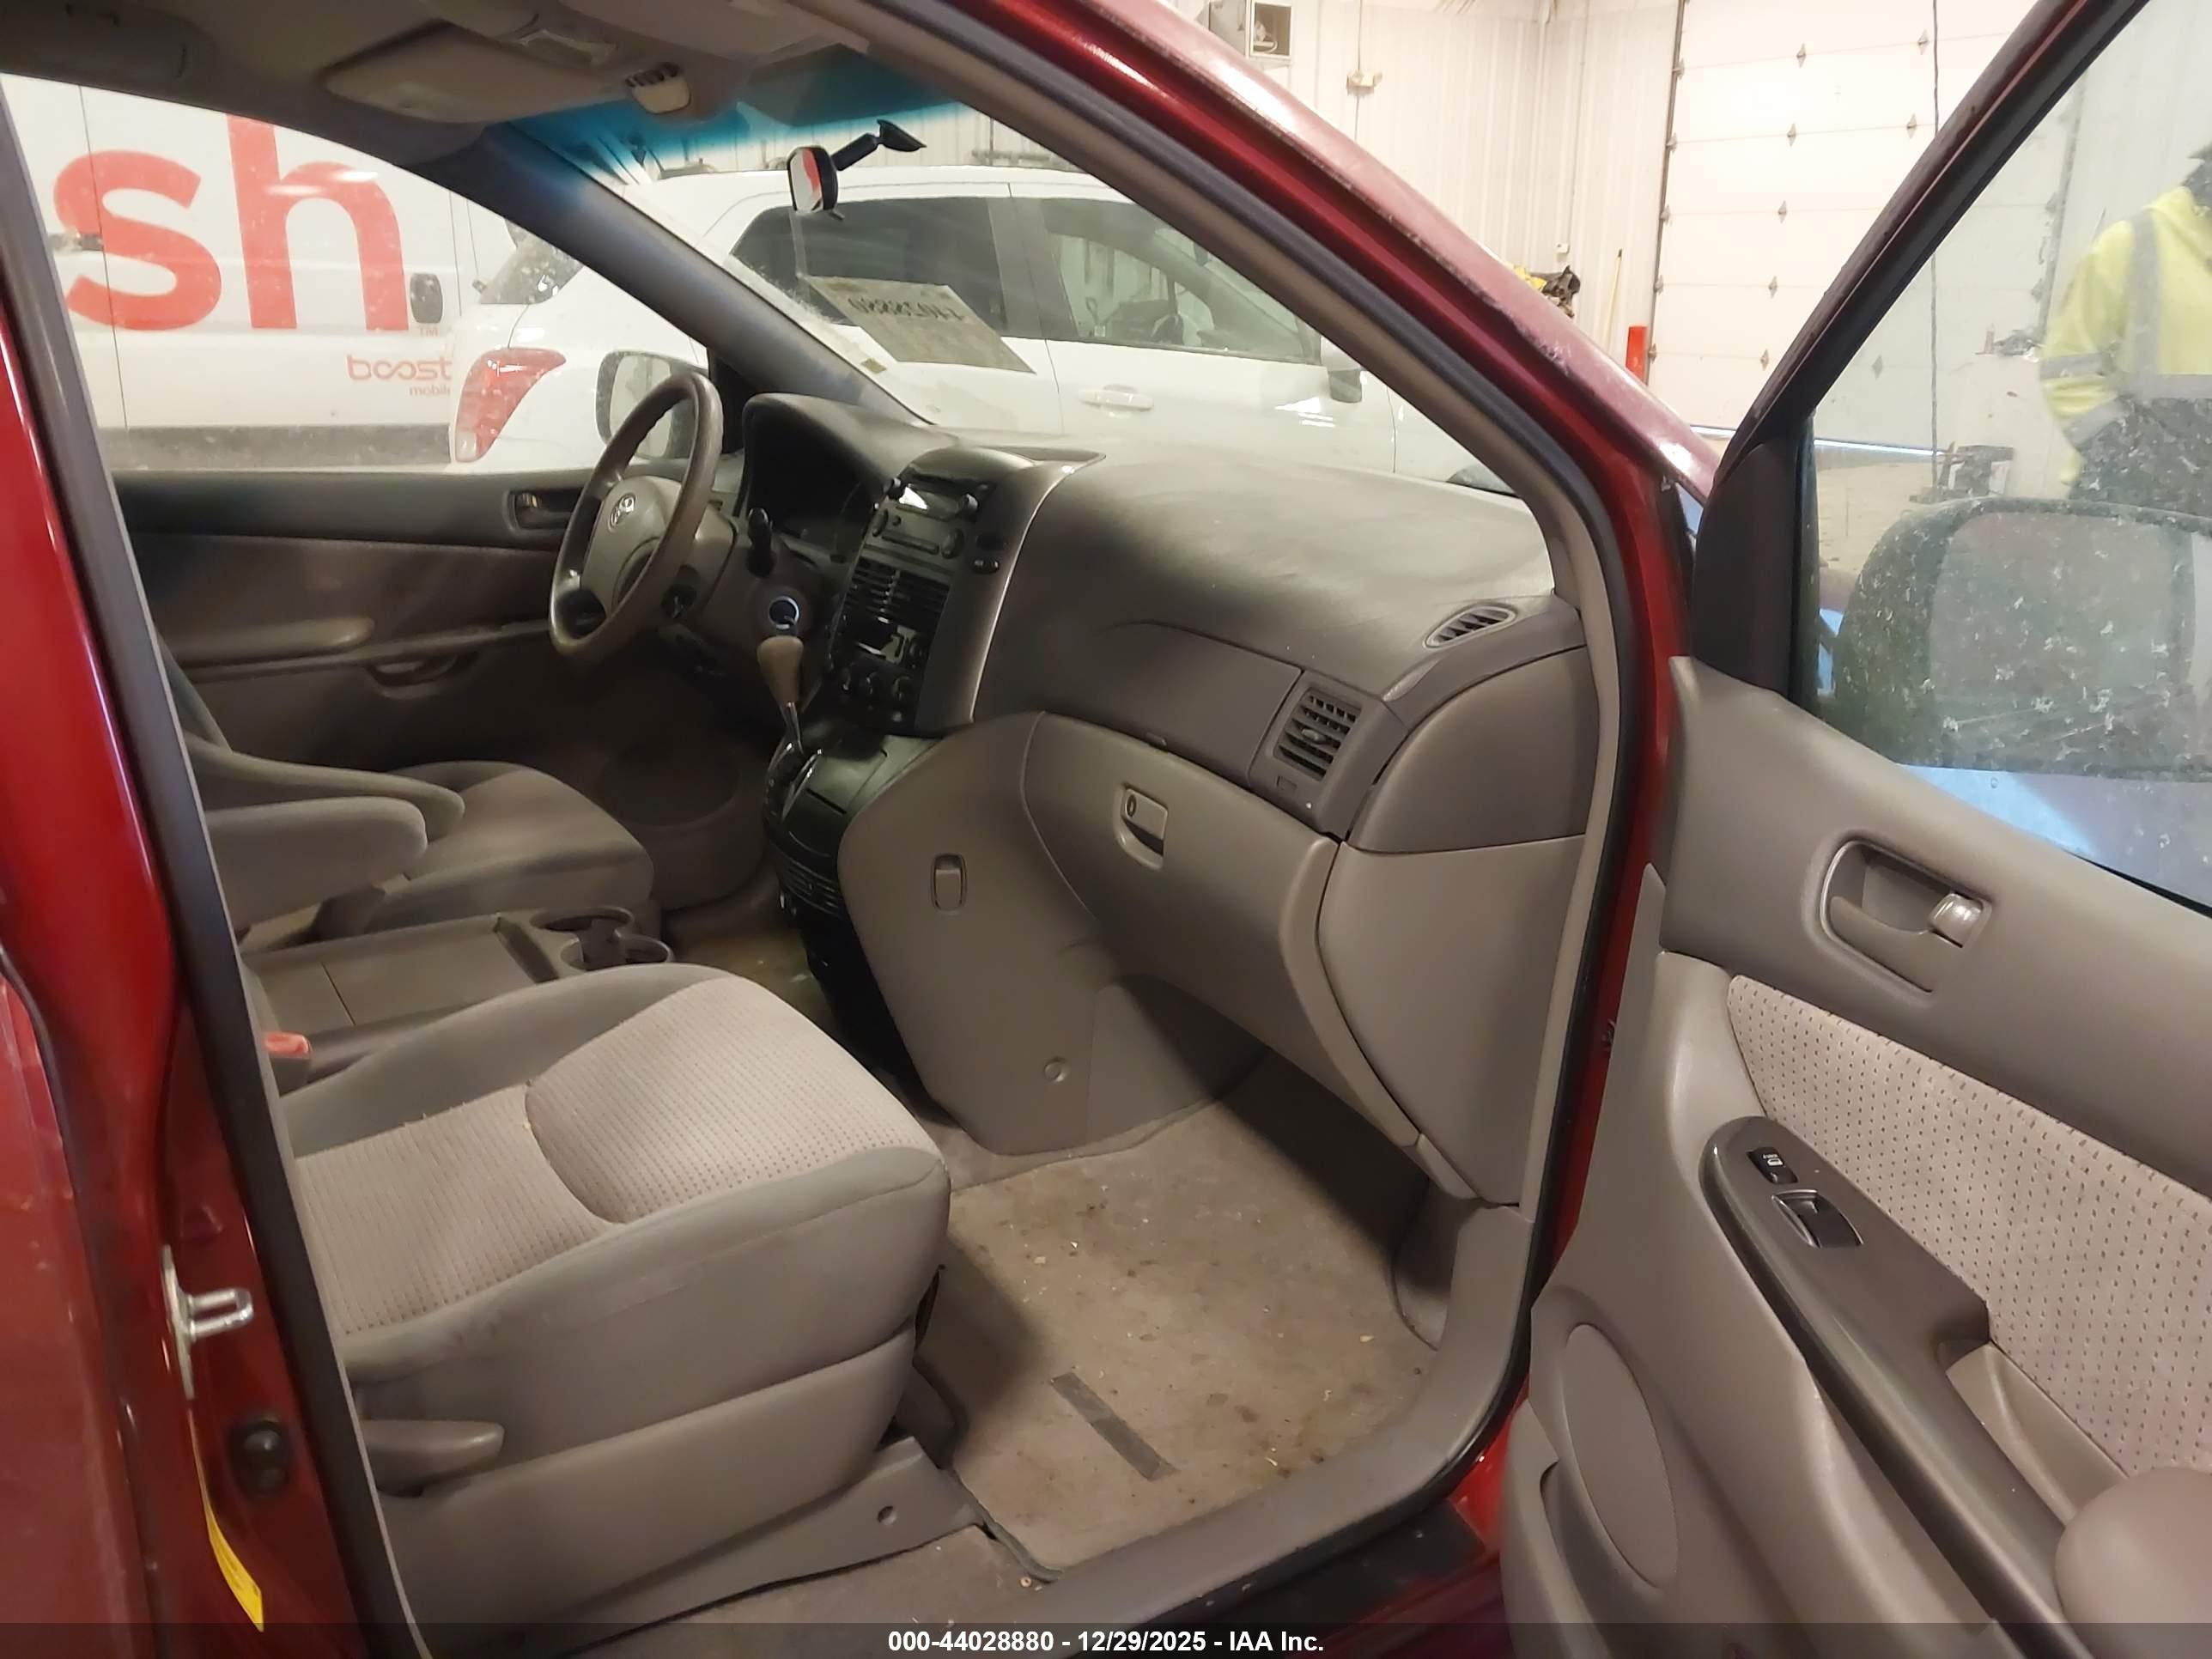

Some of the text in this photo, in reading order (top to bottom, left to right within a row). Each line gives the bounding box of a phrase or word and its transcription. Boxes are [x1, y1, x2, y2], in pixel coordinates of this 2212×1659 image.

[53, 113, 409, 331] sh
[347, 356, 453, 381] boost
[409, 385, 451, 397] mobil
